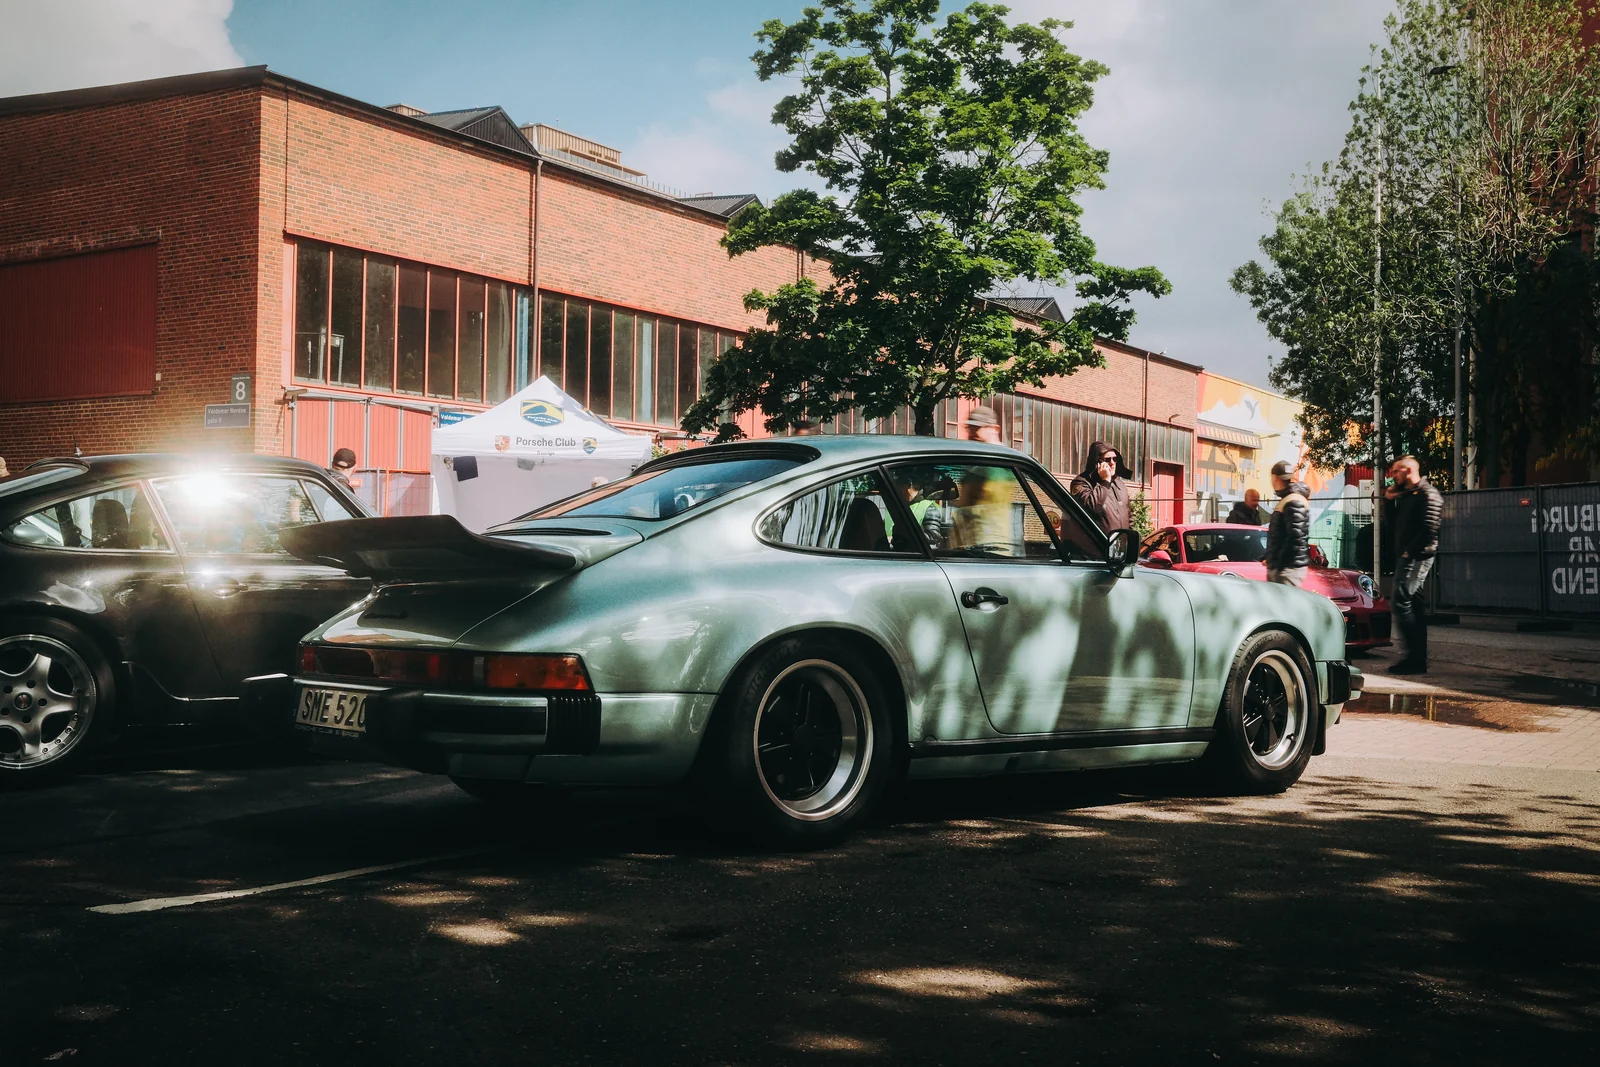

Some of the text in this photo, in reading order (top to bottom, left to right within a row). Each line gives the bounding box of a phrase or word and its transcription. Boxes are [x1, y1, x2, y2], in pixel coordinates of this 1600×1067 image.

[236, 381, 246, 400] 8
[516, 436, 576, 447] Porsche Club
[302, 689, 334, 722] SME
